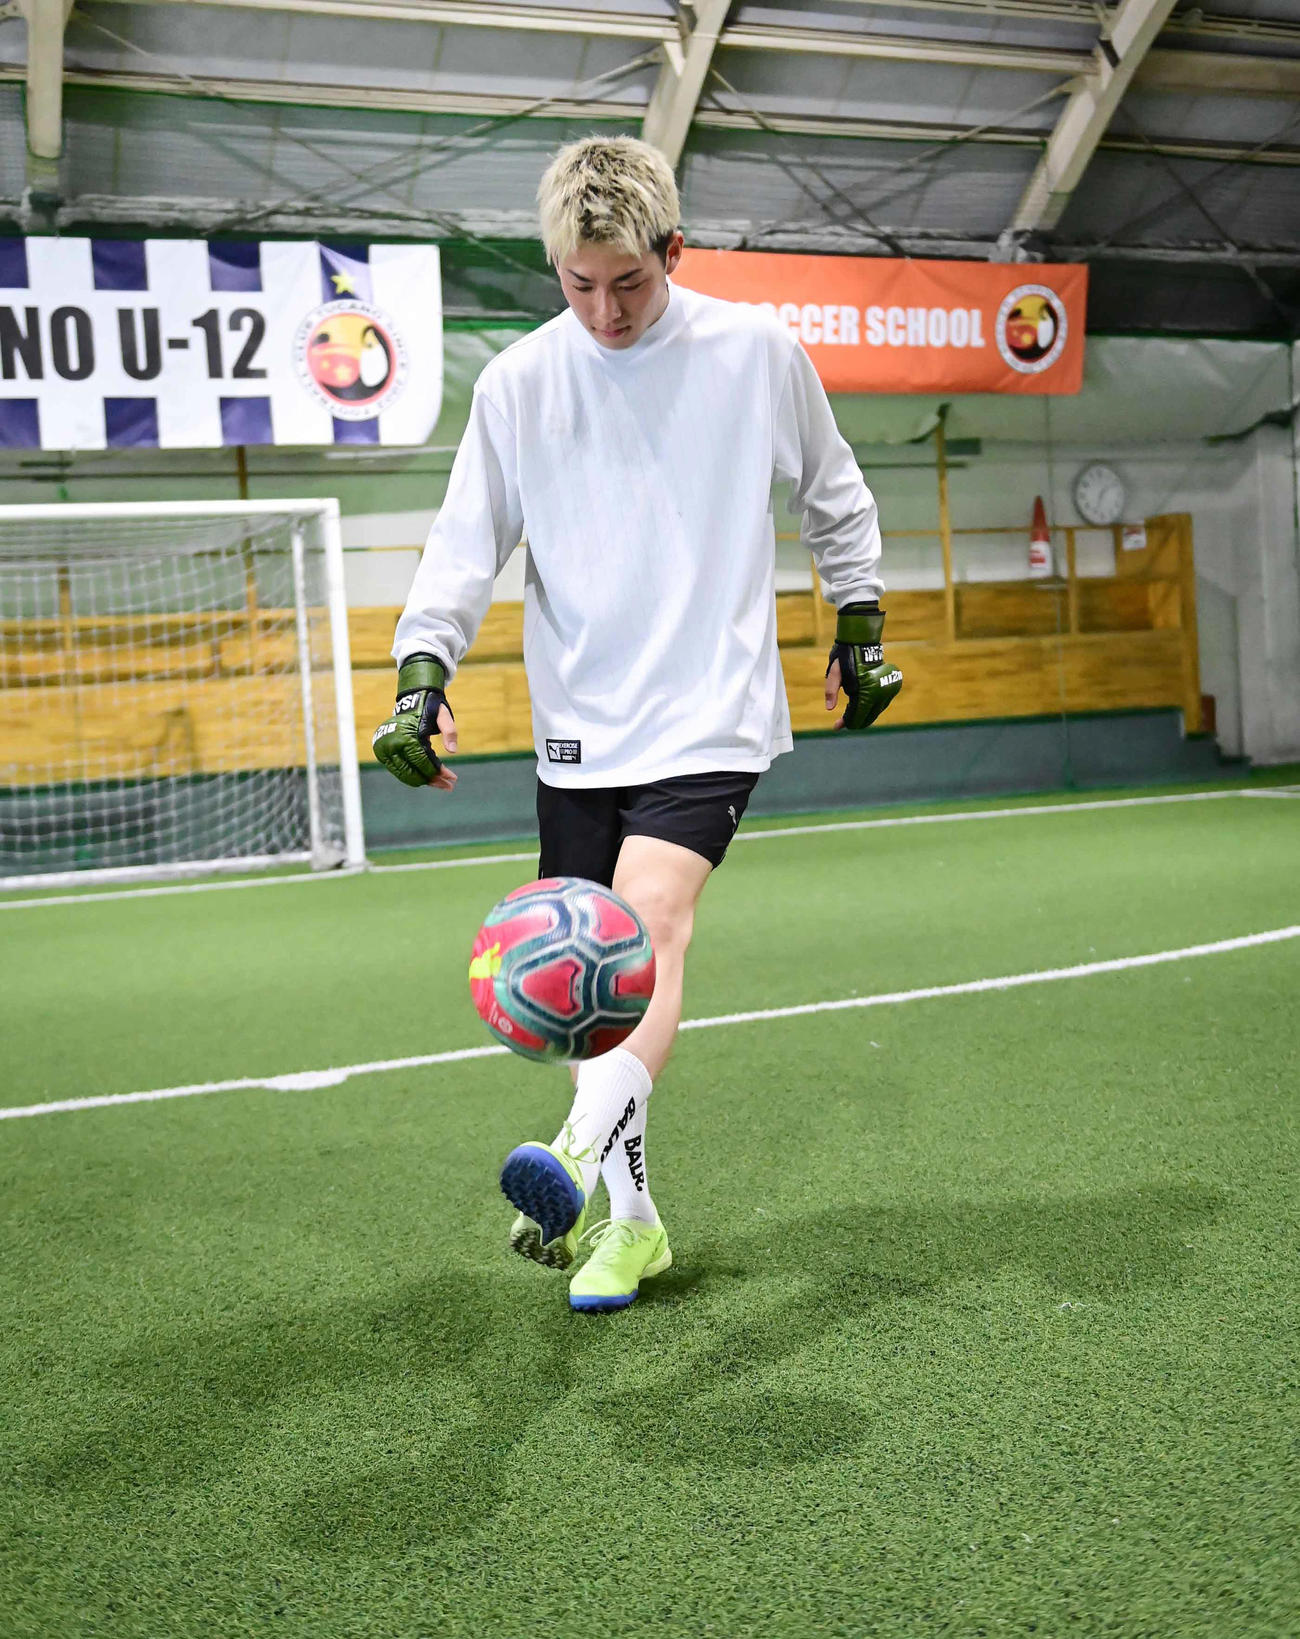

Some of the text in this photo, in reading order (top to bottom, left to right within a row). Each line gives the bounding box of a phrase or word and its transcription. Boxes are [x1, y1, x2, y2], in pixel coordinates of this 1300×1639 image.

[117, 307, 267, 380] U-12
[865, 305, 986, 348] SCHOOL
[623, 1134, 646, 1193] BALR.
